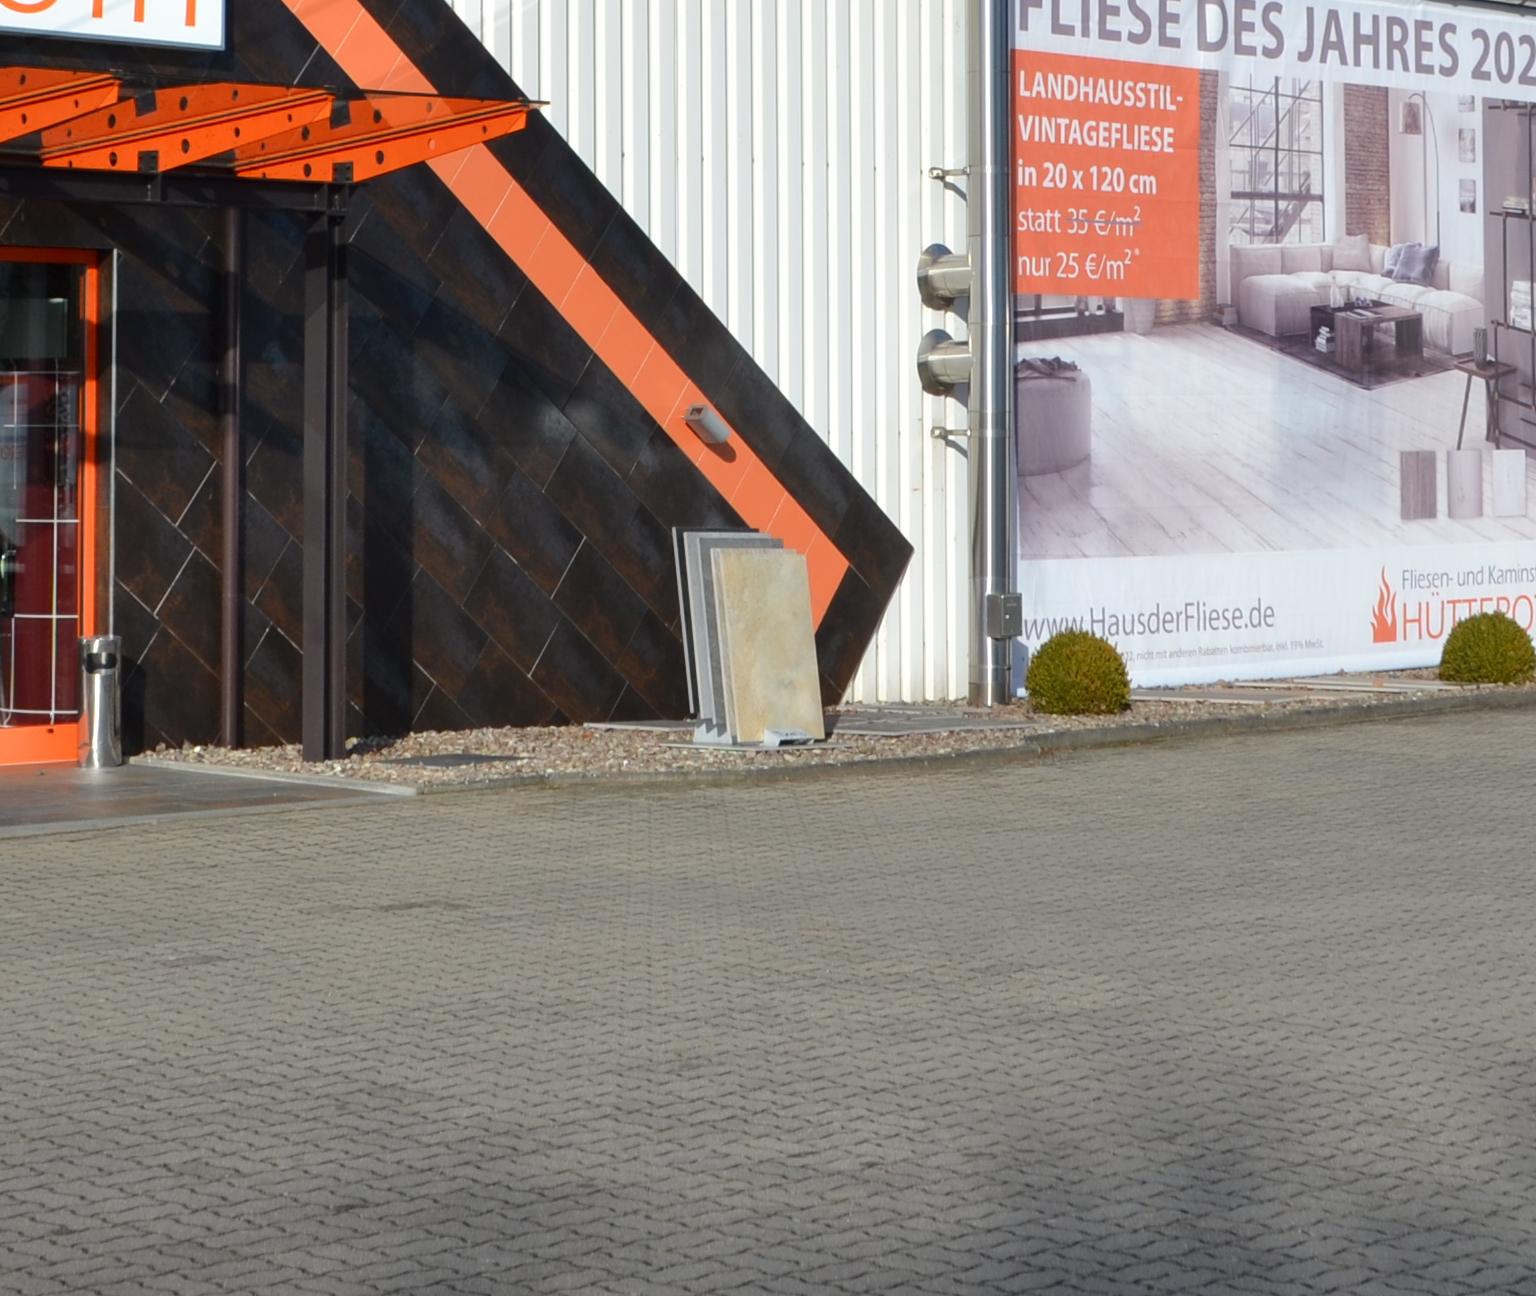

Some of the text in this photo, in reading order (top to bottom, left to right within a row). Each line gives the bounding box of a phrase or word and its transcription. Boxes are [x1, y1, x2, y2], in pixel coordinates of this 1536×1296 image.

[1296, 6, 1459, 78] JAHRES
[1019, 69, 1184, 111] LANDHAUSSTIL-
[1018, 114, 1175, 153] VINTAGEFLIESE
[1017, 158, 1157, 194] in 20 x 120 cm
[1017, 208, 1062, 233] statt
[1067, 208, 1088, 234] 35
[1017, 255, 1051, 277] nur
[1056, 252, 1079, 279] 25
[1402, 566, 1453, 590] Fliesen-
[1457, 566, 1485, 587] und
